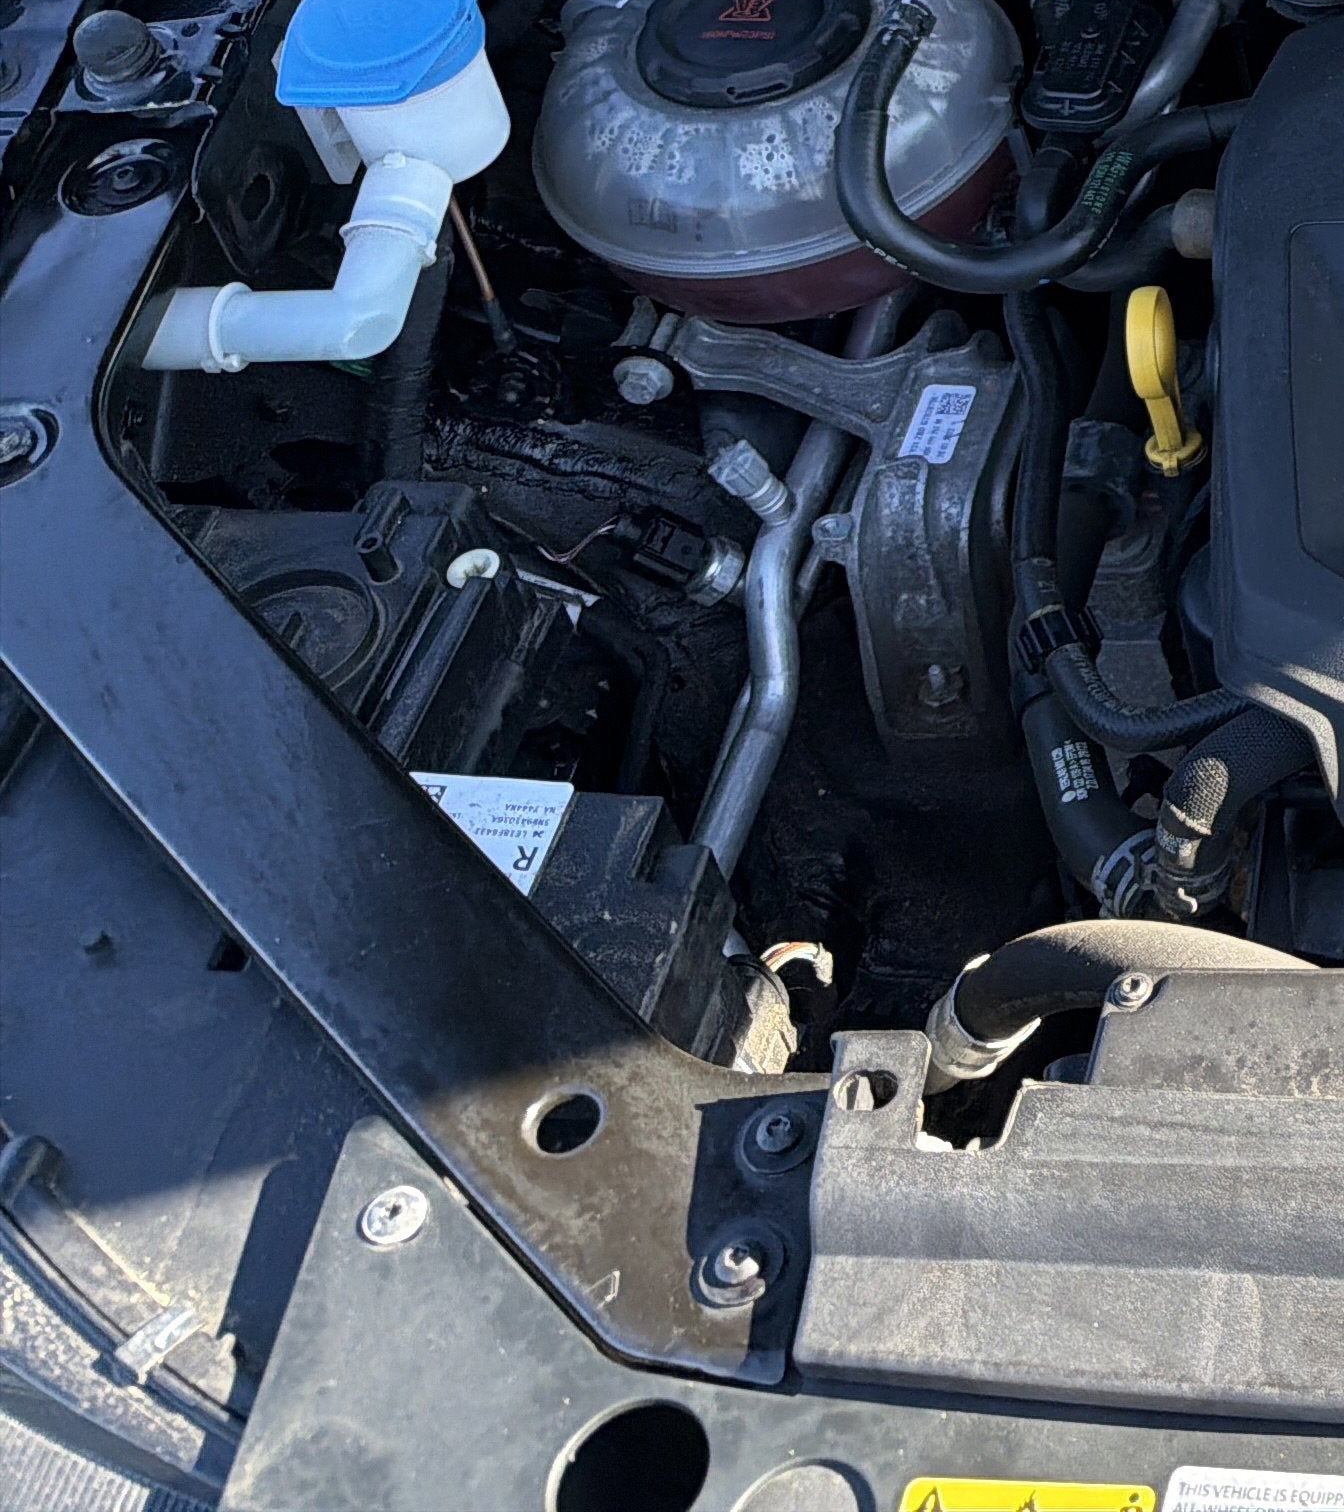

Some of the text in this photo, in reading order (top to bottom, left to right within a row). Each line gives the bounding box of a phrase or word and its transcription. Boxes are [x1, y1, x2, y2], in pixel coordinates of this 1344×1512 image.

[513, 845, 540, 871] R
[1178, 1481, 1210, 1497] THIS
[1213, 1485, 1271, 1501] VEHICLE
[1273, 1489, 1287, 1503] IS
